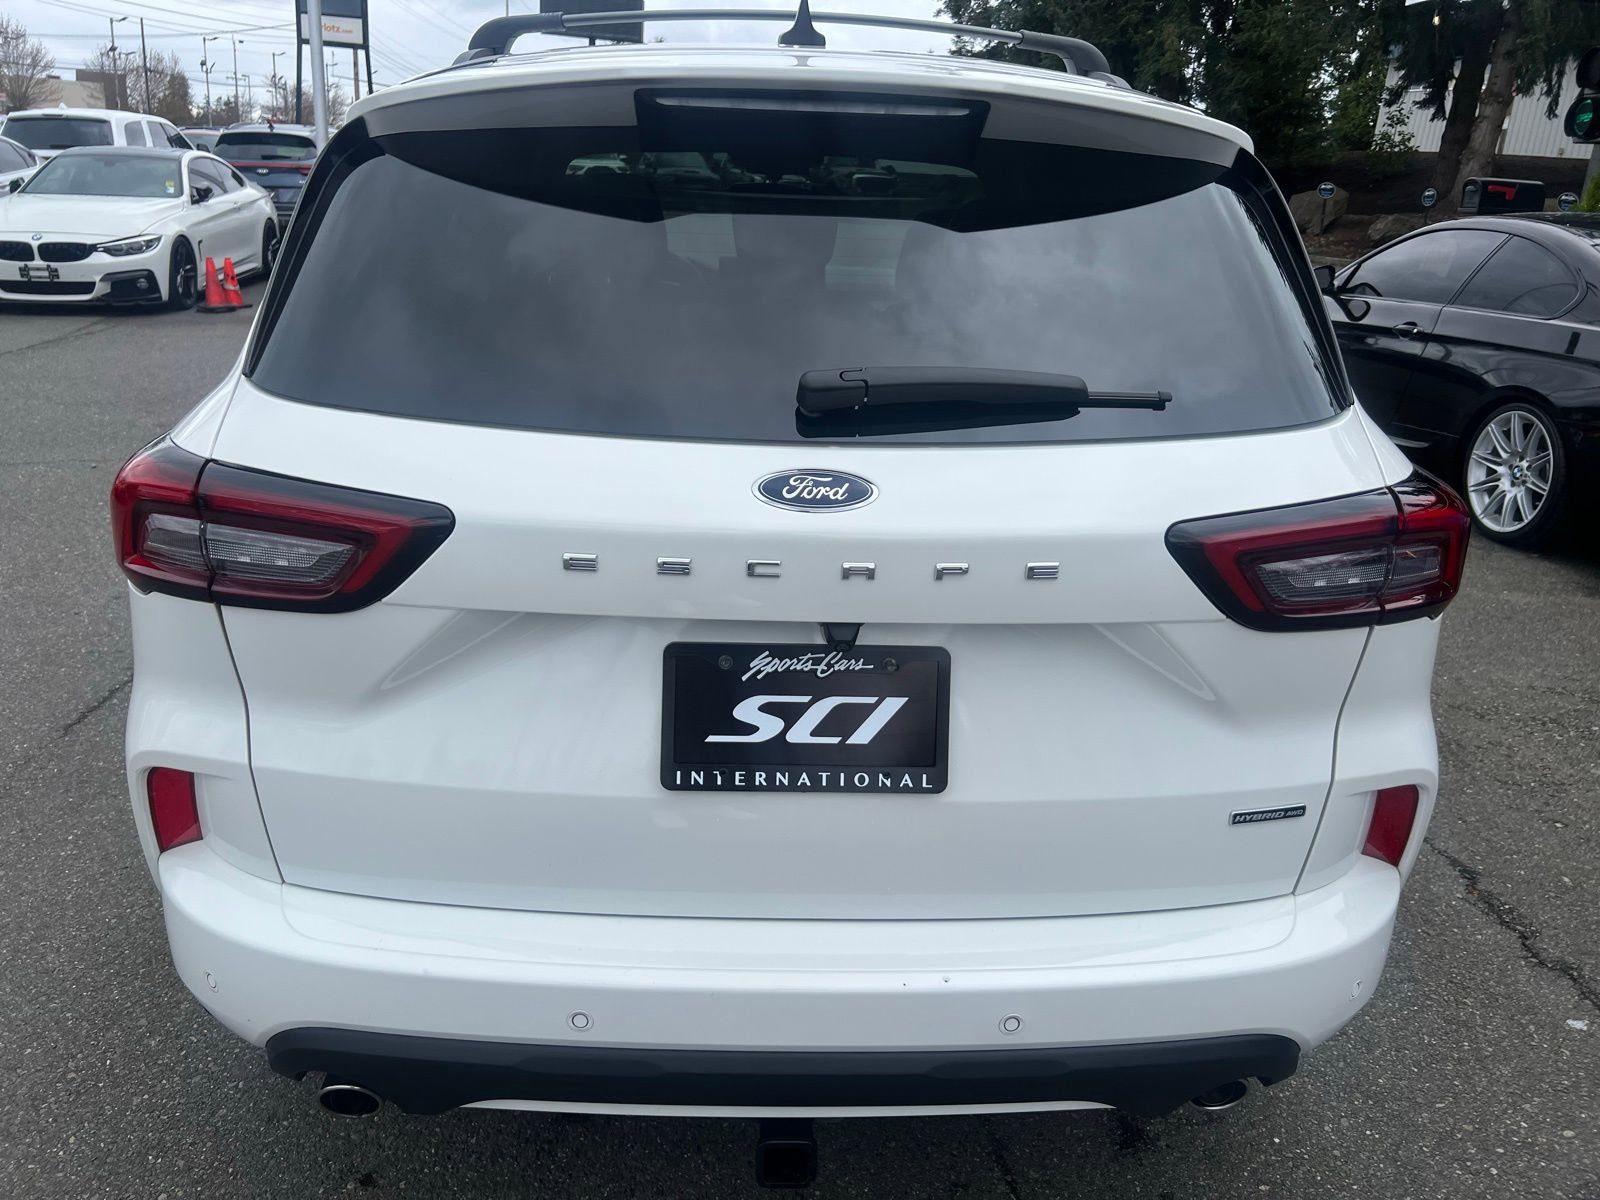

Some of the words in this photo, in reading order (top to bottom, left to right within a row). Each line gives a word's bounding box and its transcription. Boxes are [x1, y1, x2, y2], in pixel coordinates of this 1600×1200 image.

[782, 475, 849, 500] Ford
[562, 552, 1061, 581] ESCAPE
[741, 650, 824, 682] Sports
[816, 651, 874, 678] Cars
[704, 694, 909, 745] SCI
[675, 769, 934, 788] INTERNATIONAL
[1234, 811, 1285, 823] HYBRID
[1285, 809, 1303, 817] AWD
